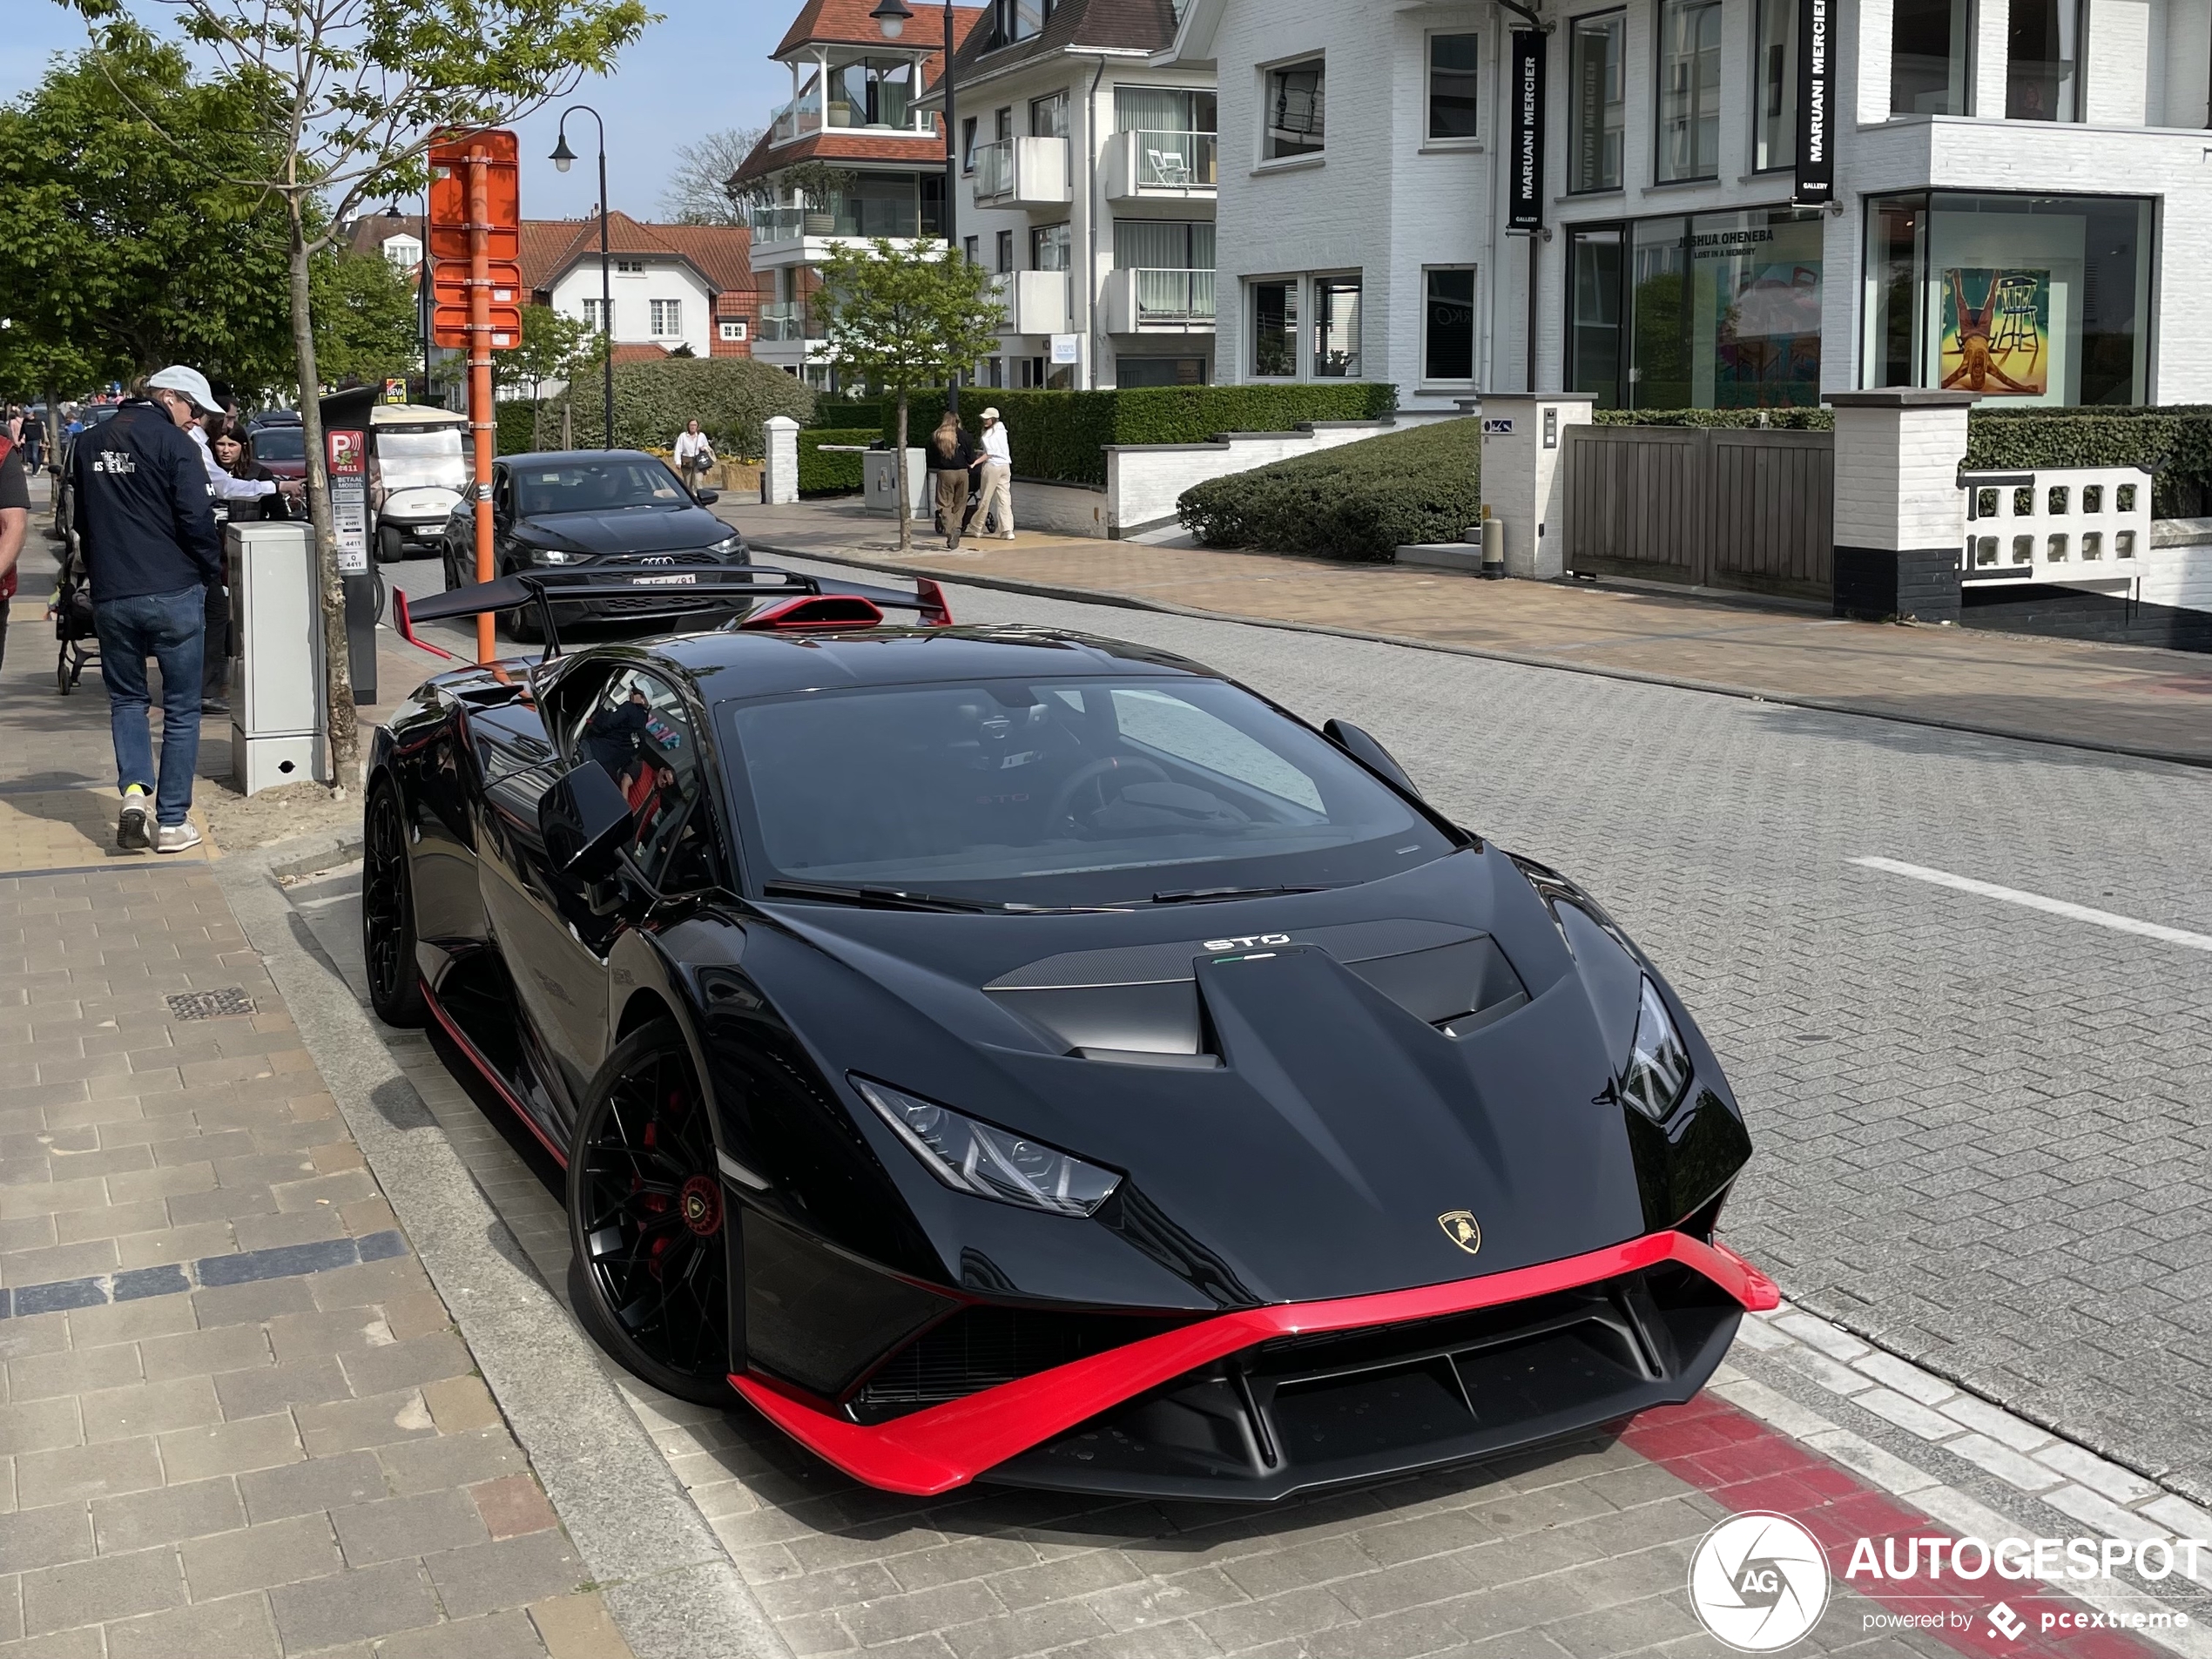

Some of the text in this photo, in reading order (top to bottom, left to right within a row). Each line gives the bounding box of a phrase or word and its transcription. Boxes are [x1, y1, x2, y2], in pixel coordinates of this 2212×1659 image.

[1522, 57, 1535, 199] MARUANI MERCIER
[1810, 79, 1824, 162] MARUANI
[1721, 229, 1774, 245] OHENEBA
[1694, 250, 1710, 259] LOST
[1725, 247, 1757, 257] MEMORY
[332, 435, 351, 463] P
[93, 461, 104, 471] IS
[1203, 934, 1291, 951] STO
